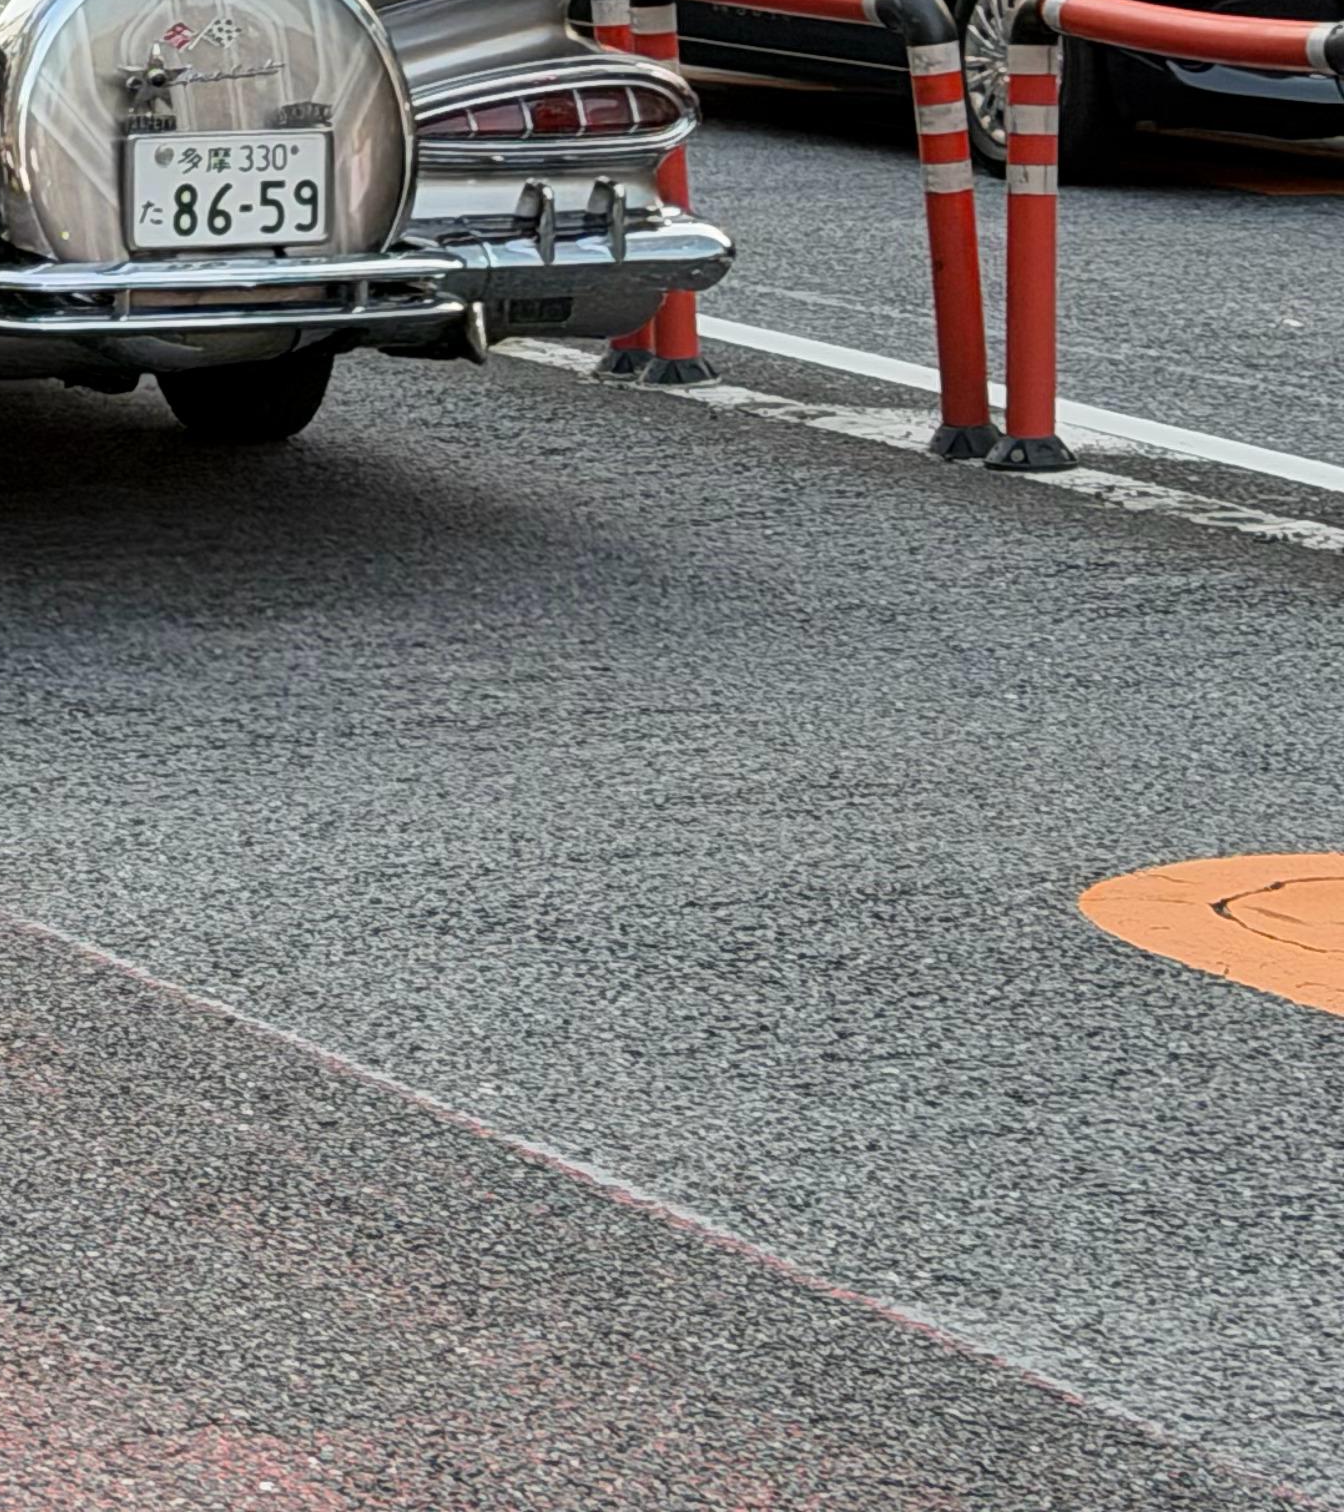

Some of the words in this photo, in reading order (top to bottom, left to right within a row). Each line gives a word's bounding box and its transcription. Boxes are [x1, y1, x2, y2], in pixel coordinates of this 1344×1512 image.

[177, 146, 232, 174] 多摩
[238, 143, 288, 172] 330
[139, 200, 164, 225] た
[173, 178, 319, 237] 86-59
